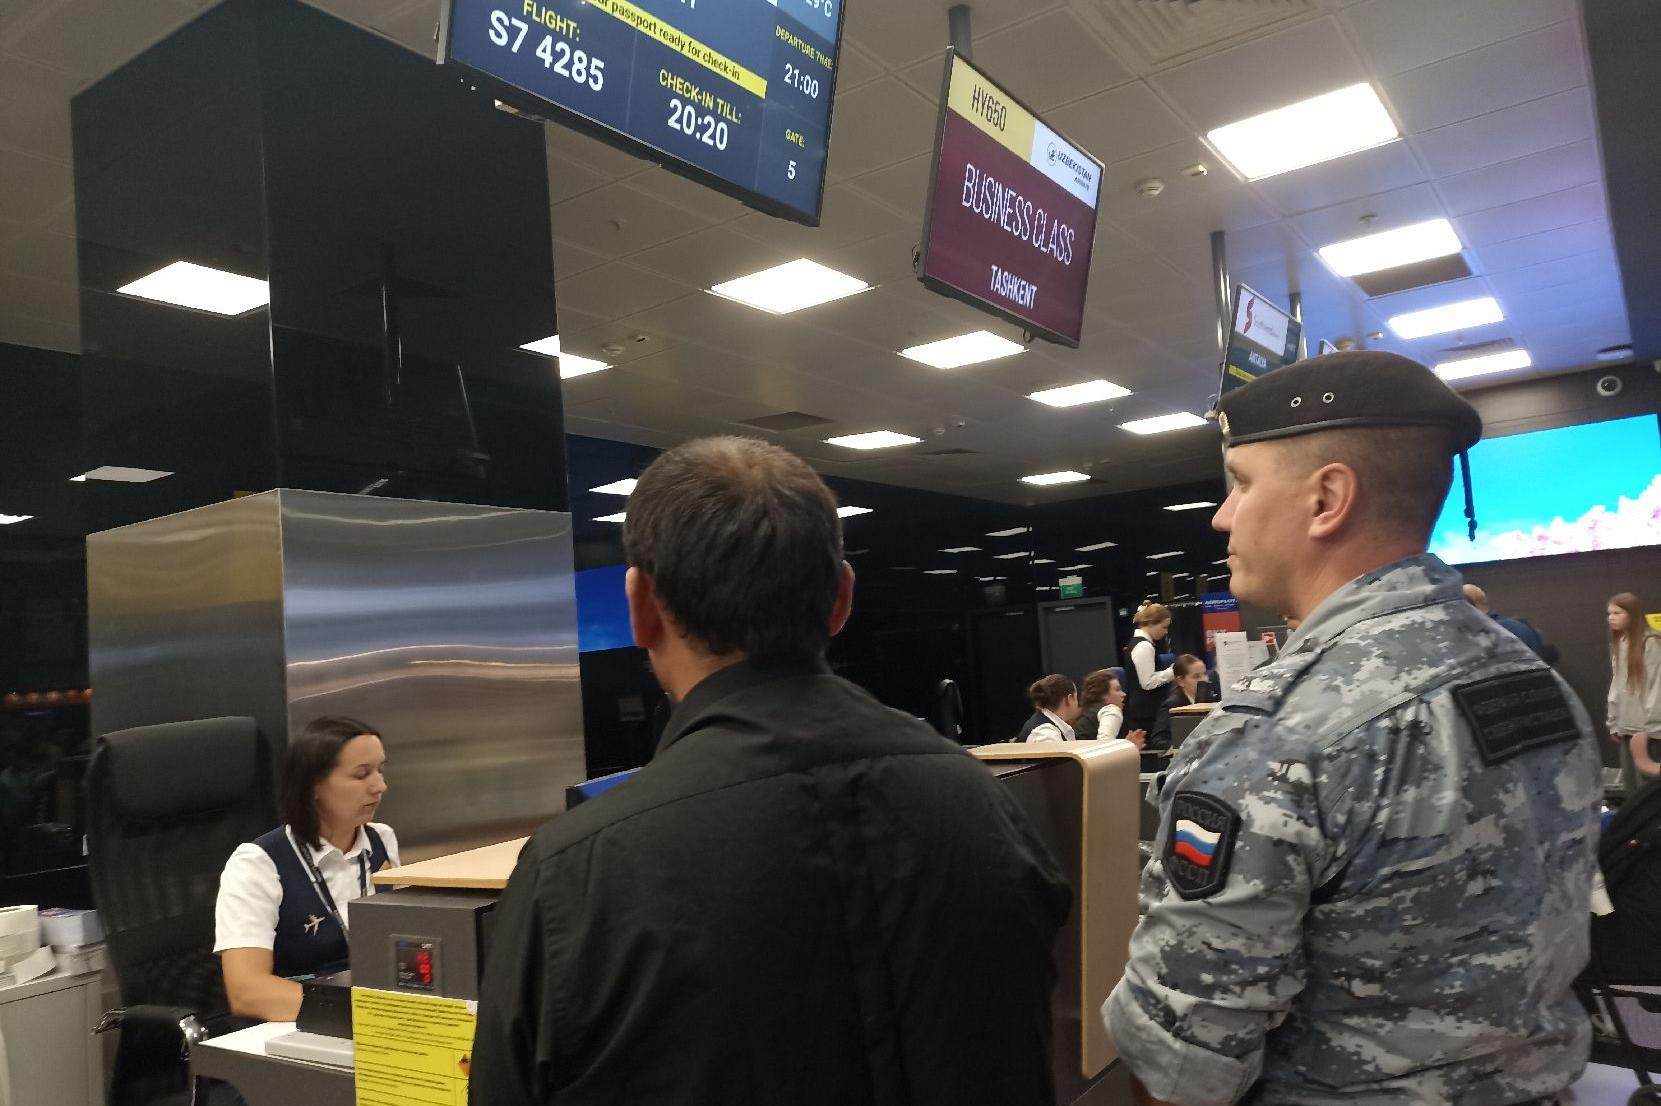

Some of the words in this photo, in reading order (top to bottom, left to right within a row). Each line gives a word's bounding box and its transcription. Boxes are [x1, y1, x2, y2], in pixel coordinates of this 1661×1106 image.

[523, 0, 580, 42] FLIGHT:
[612, 2, 657, 35] passport
[659, 28, 686, 54] ready
[688, 41, 702, 57] for
[703, 51, 740, 81] check-in
[775, 25, 815, 59] DEPARTURE
[489, 10, 529, 53] S7
[536, 35, 605, 91] 4285
[659, 69, 715, 110] CHECK-IN
[717, 98, 742, 125] TILL:
[783, 63, 819, 98] 21:00
[667, 98, 728, 151] 20:20
[971, 84, 1007, 132] HY650
[785, 129, 805, 147] GATE:
[787, 160, 797, 180] 5
[1057, 151, 1092, 182] UZBEKISTAN
[962, 163, 1033, 241] BUSINESS
[1033, 208, 1075, 266] CLASS
[990, 264, 1038, 310] TASHKENT
